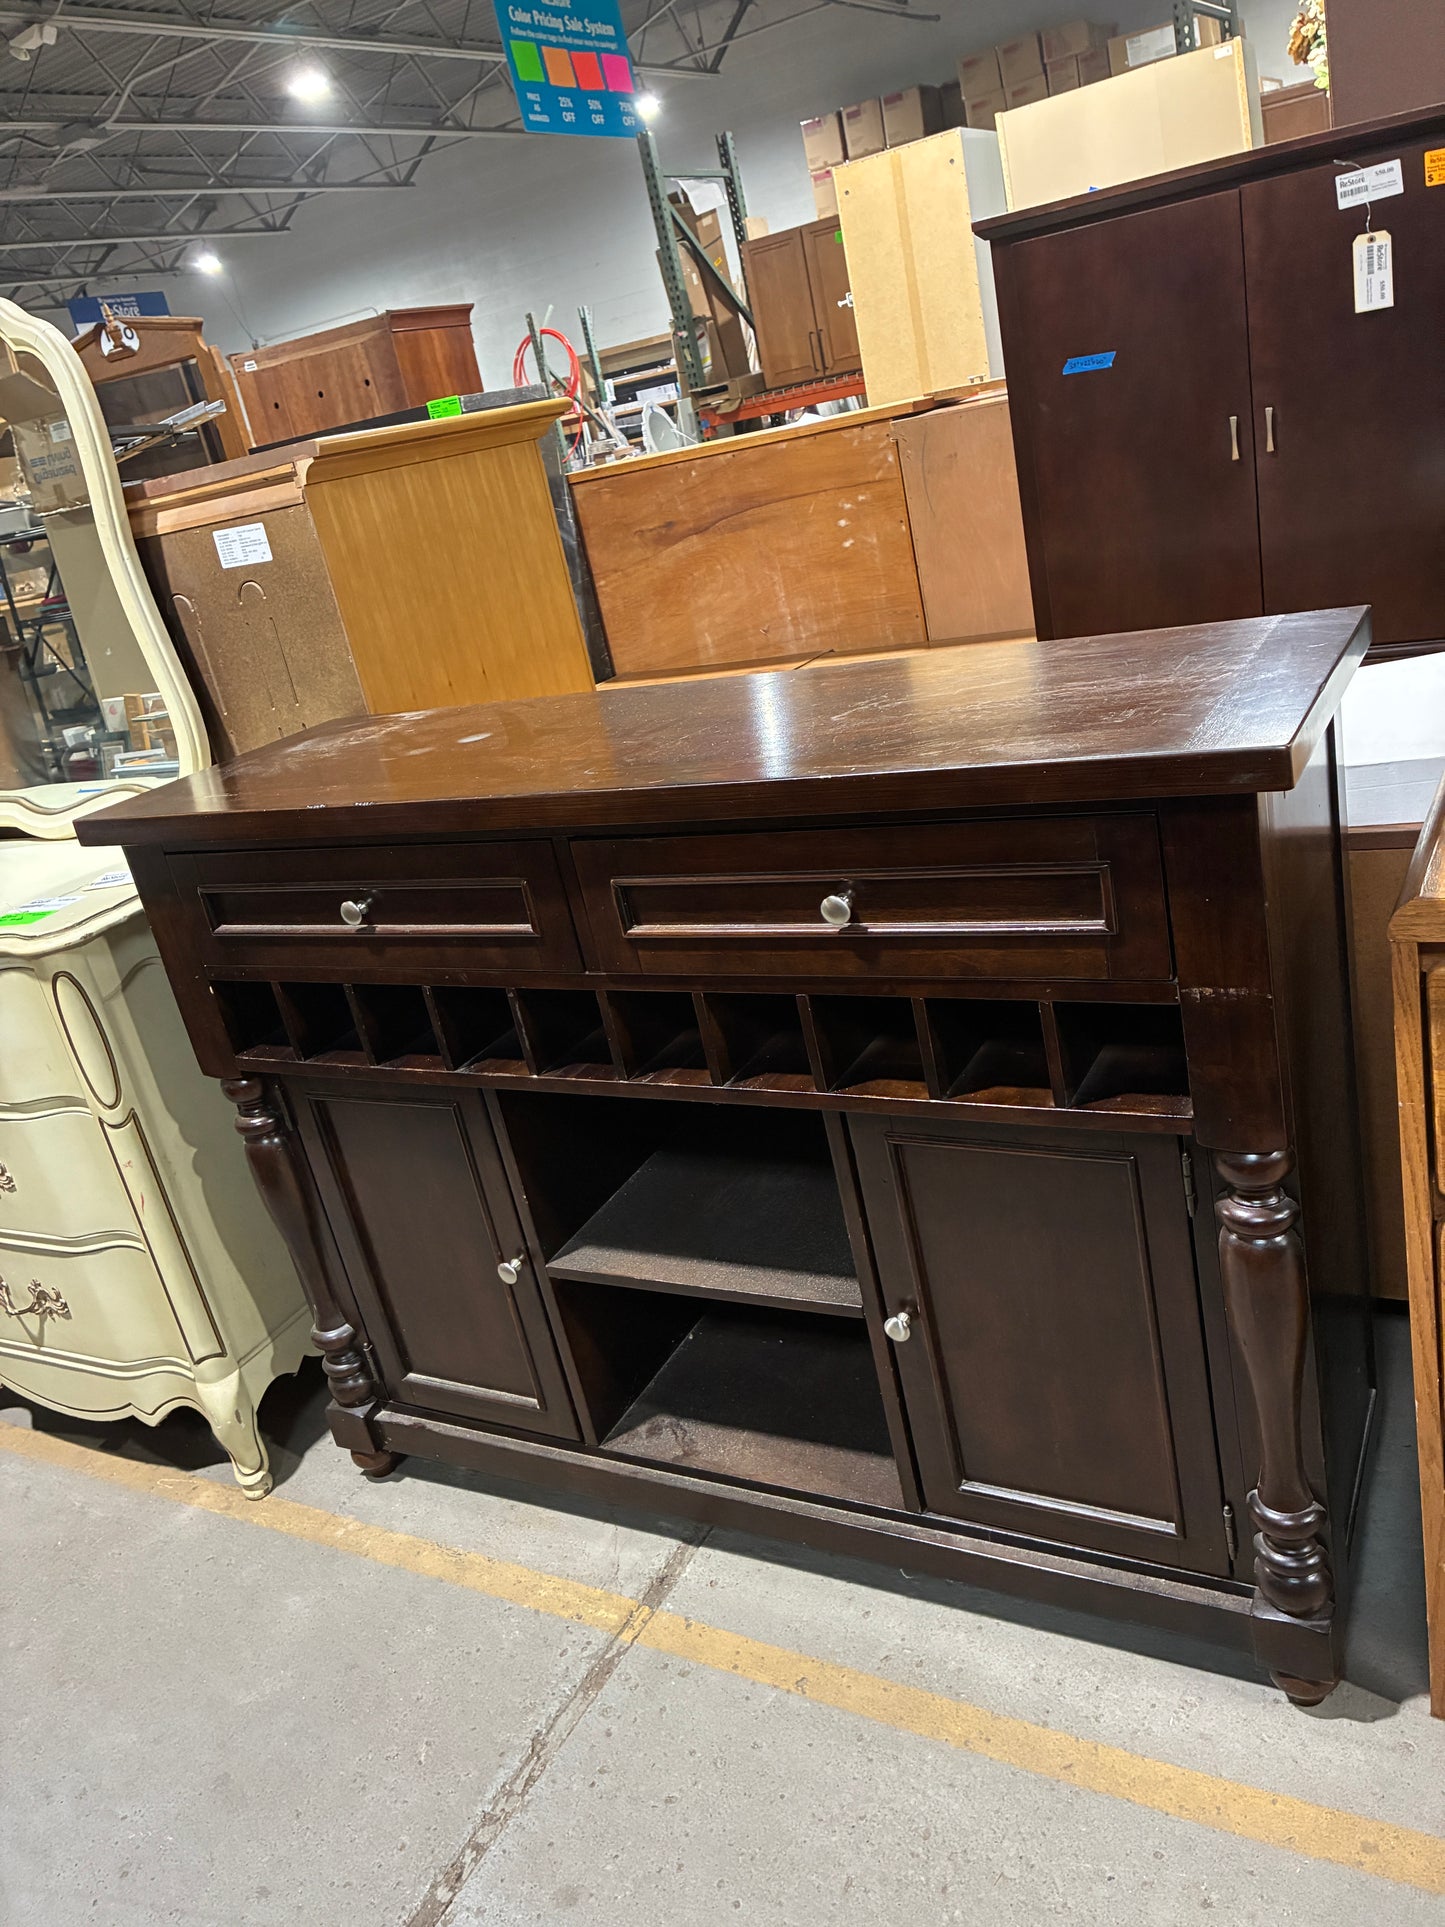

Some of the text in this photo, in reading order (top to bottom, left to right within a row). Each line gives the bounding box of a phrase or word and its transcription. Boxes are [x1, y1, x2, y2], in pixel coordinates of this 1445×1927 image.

[508, 5, 616, 37] Color Pricing Sale System
[558, 96, 573, 108] 25%
[587, 99, 602, 110] 50%
[562, 112, 576, 123] OFF
[591, 114, 605, 125] OFF
[622, 116, 636, 127] OFF
[1339, 176, 1366, 189] ReStore
